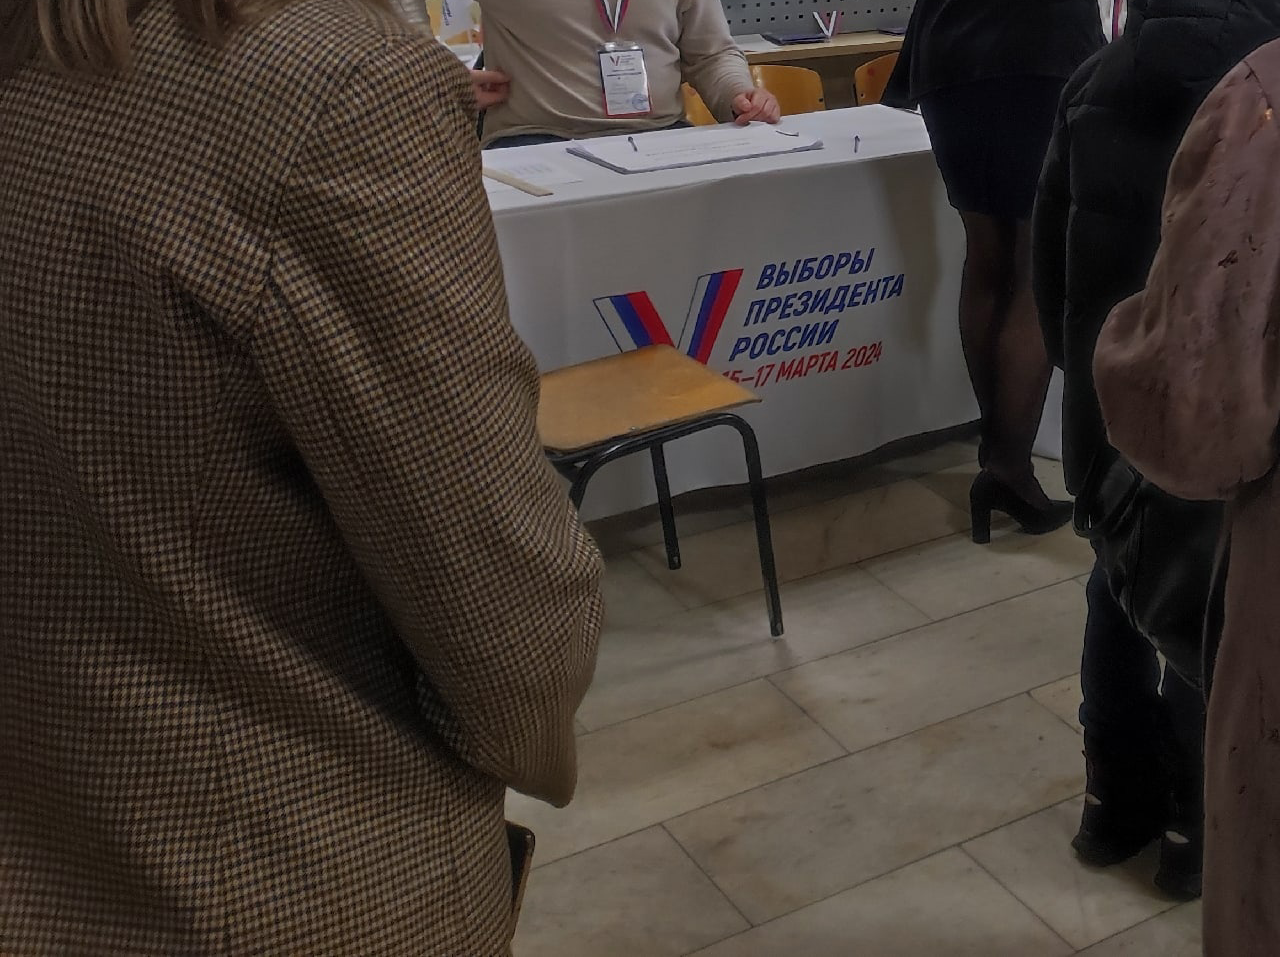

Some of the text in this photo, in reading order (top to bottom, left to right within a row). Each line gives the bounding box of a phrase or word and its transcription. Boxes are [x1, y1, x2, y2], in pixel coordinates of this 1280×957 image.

[756, 248, 876, 290] ВЫБОРЫ
[743, 273, 905, 327] ПРЕЗИДЕНТА
[728, 319, 840, 362] РОССИИ
[775, 350, 839, 383] МАРТА
[841, 341, 883, 371] 2024
